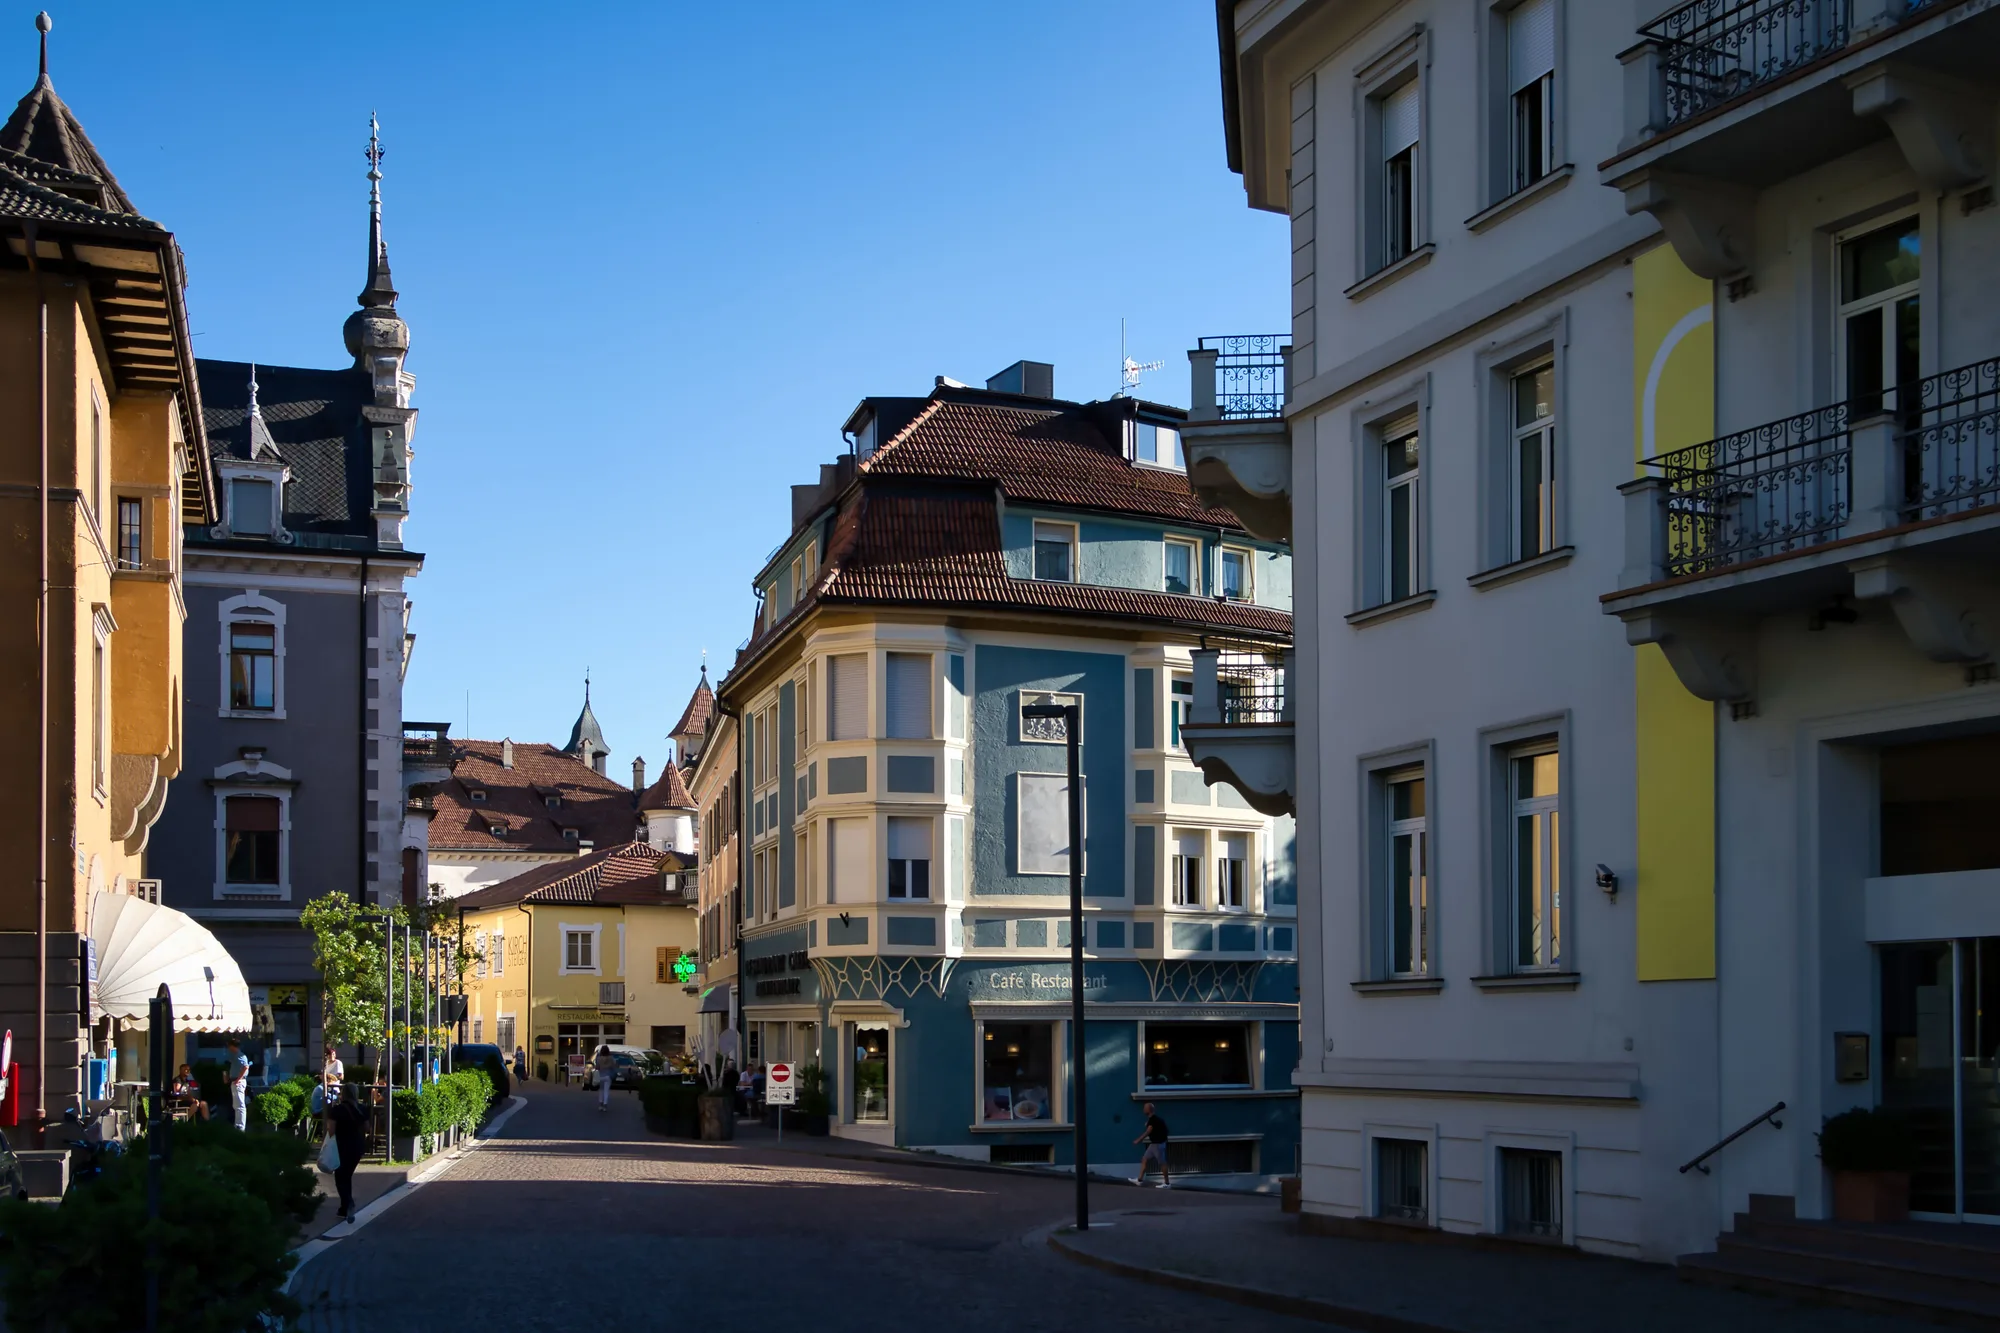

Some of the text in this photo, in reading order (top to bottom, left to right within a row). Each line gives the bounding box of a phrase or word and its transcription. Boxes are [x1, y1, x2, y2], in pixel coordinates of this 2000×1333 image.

[508, 934, 527, 955] KIRCH
[990, 971, 1108, 989] Café Restaant
[557, 1012, 606, 1021] RESTAURANT
